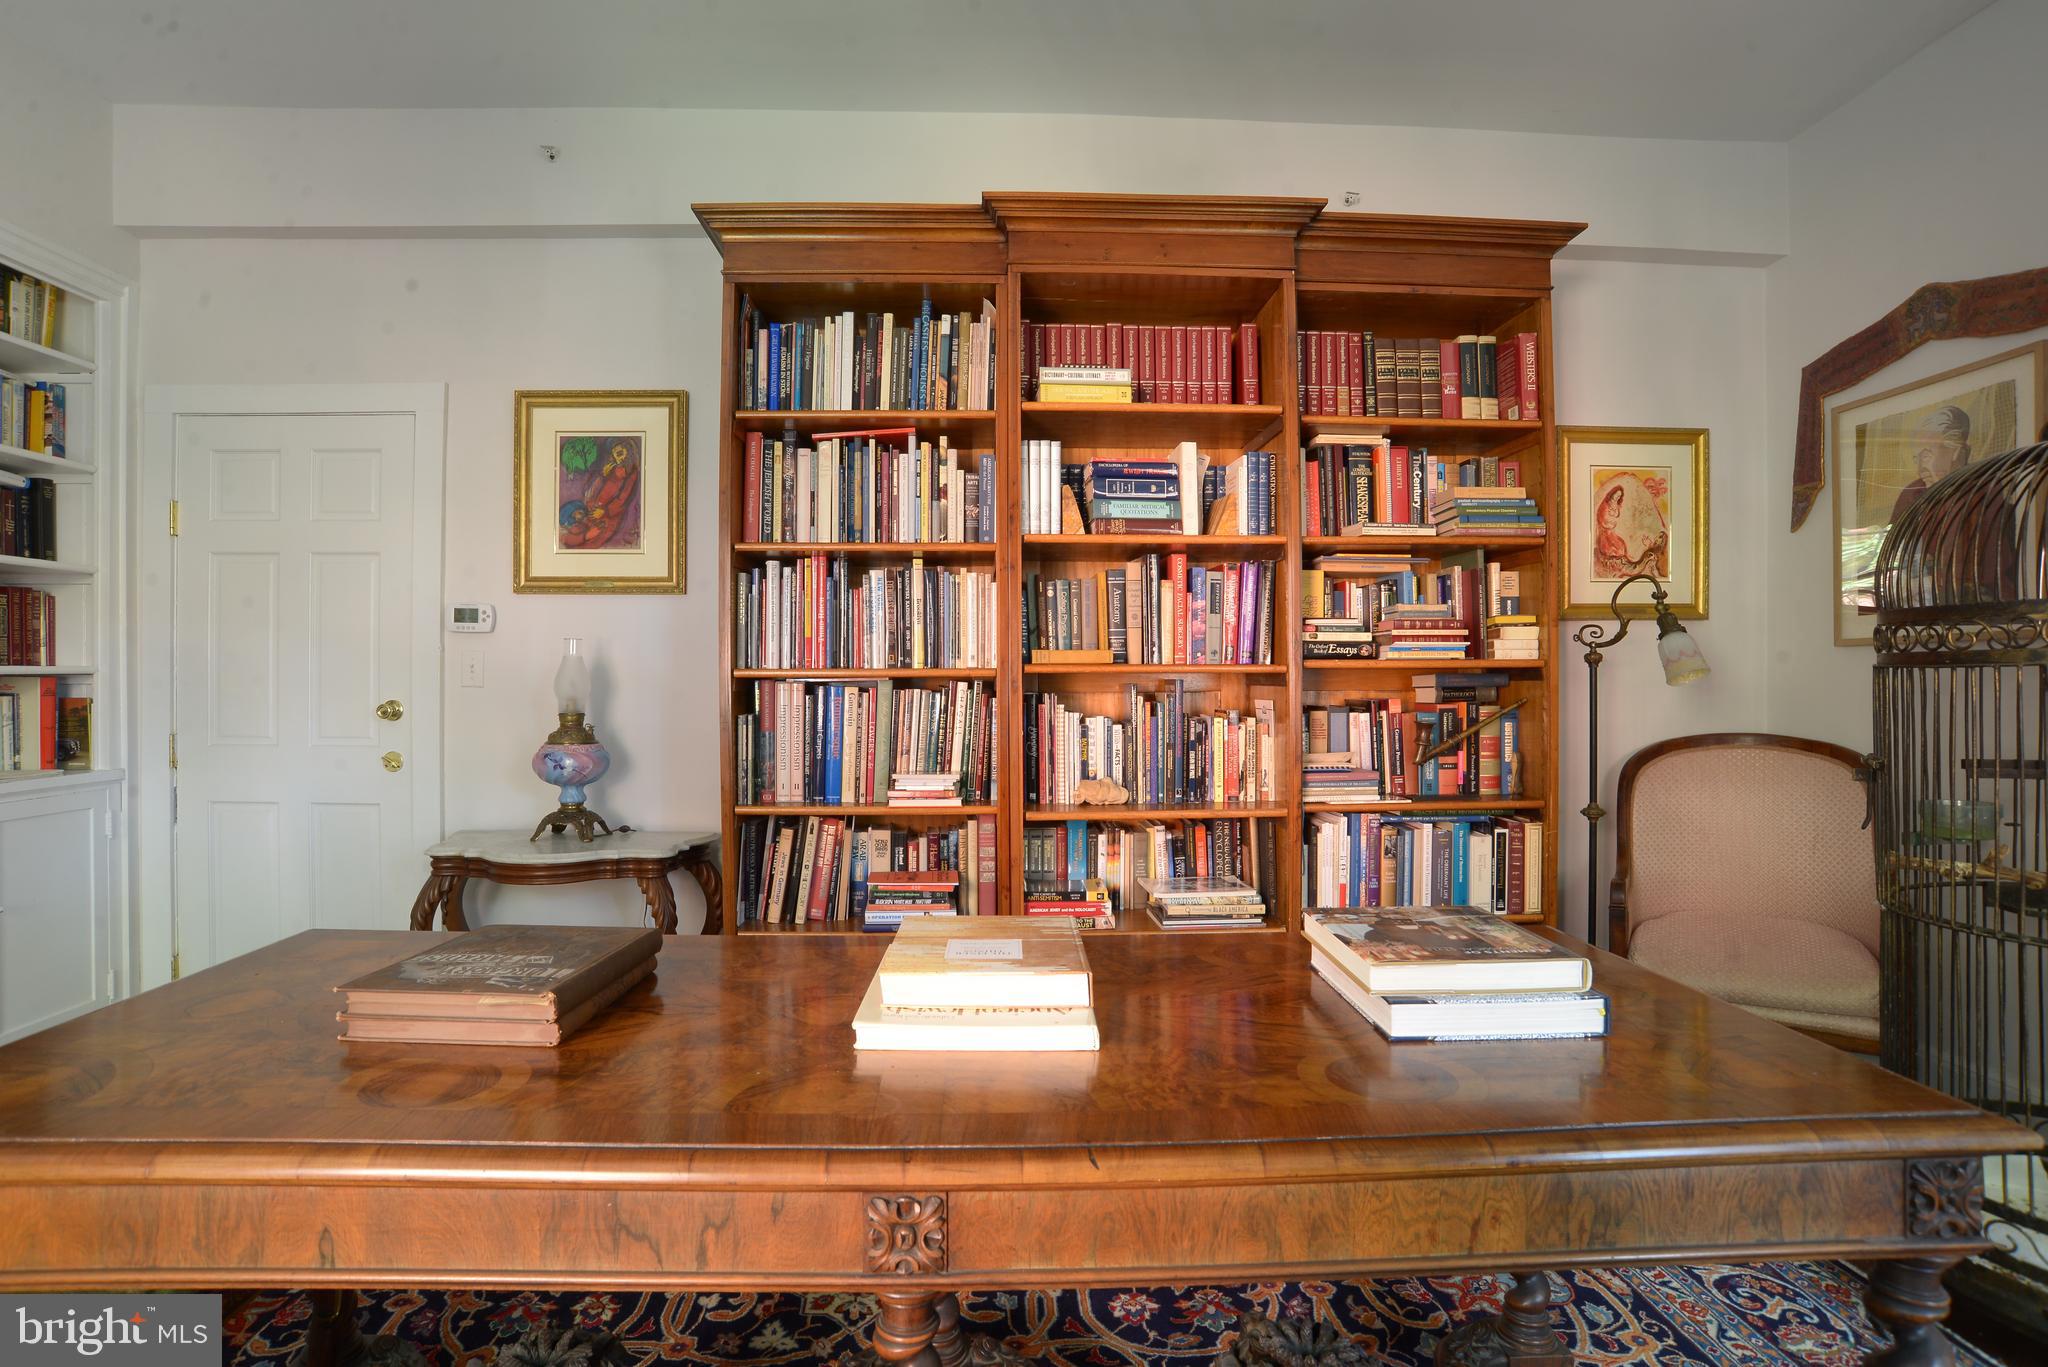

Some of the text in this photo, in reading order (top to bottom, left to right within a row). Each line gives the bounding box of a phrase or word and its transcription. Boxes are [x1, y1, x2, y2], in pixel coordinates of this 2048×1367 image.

[922, 315, 930, 350] CASTLES
[770, 374, 778, 398] WOMEN
[920, 363, 928, 400] HOUSES
[763, 449, 773, 533] THE JEWISH WORLD
[1357, 476, 1369, 524] SHAKESPEAR
[1112, 588, 1122, 625] Anatomy
[1059, 614, 1068, 637] Physics
[1327, 643, 1358, 657] Essays
[847, 692, 857, 727] Gauguin
[779, 704, 789, 771] Impressionism
[792, 704, 802, 771] Impressionism
[815, 734, 824, 759] Carpets
[868, 720, 876, 753] LOVERS
[1504, 722, 1513, 763] OBSTETRICS
[780, 852, 788, 869] Jews
[859, 838, 867, 861] ARAB
[1215, 821, 1223, 878] ENCYCLOPED
[1224, 854, 1232, 877] JEWI
[773, 877, 785, 905] Germany
[799, 883, 807, 907] CENTURY
